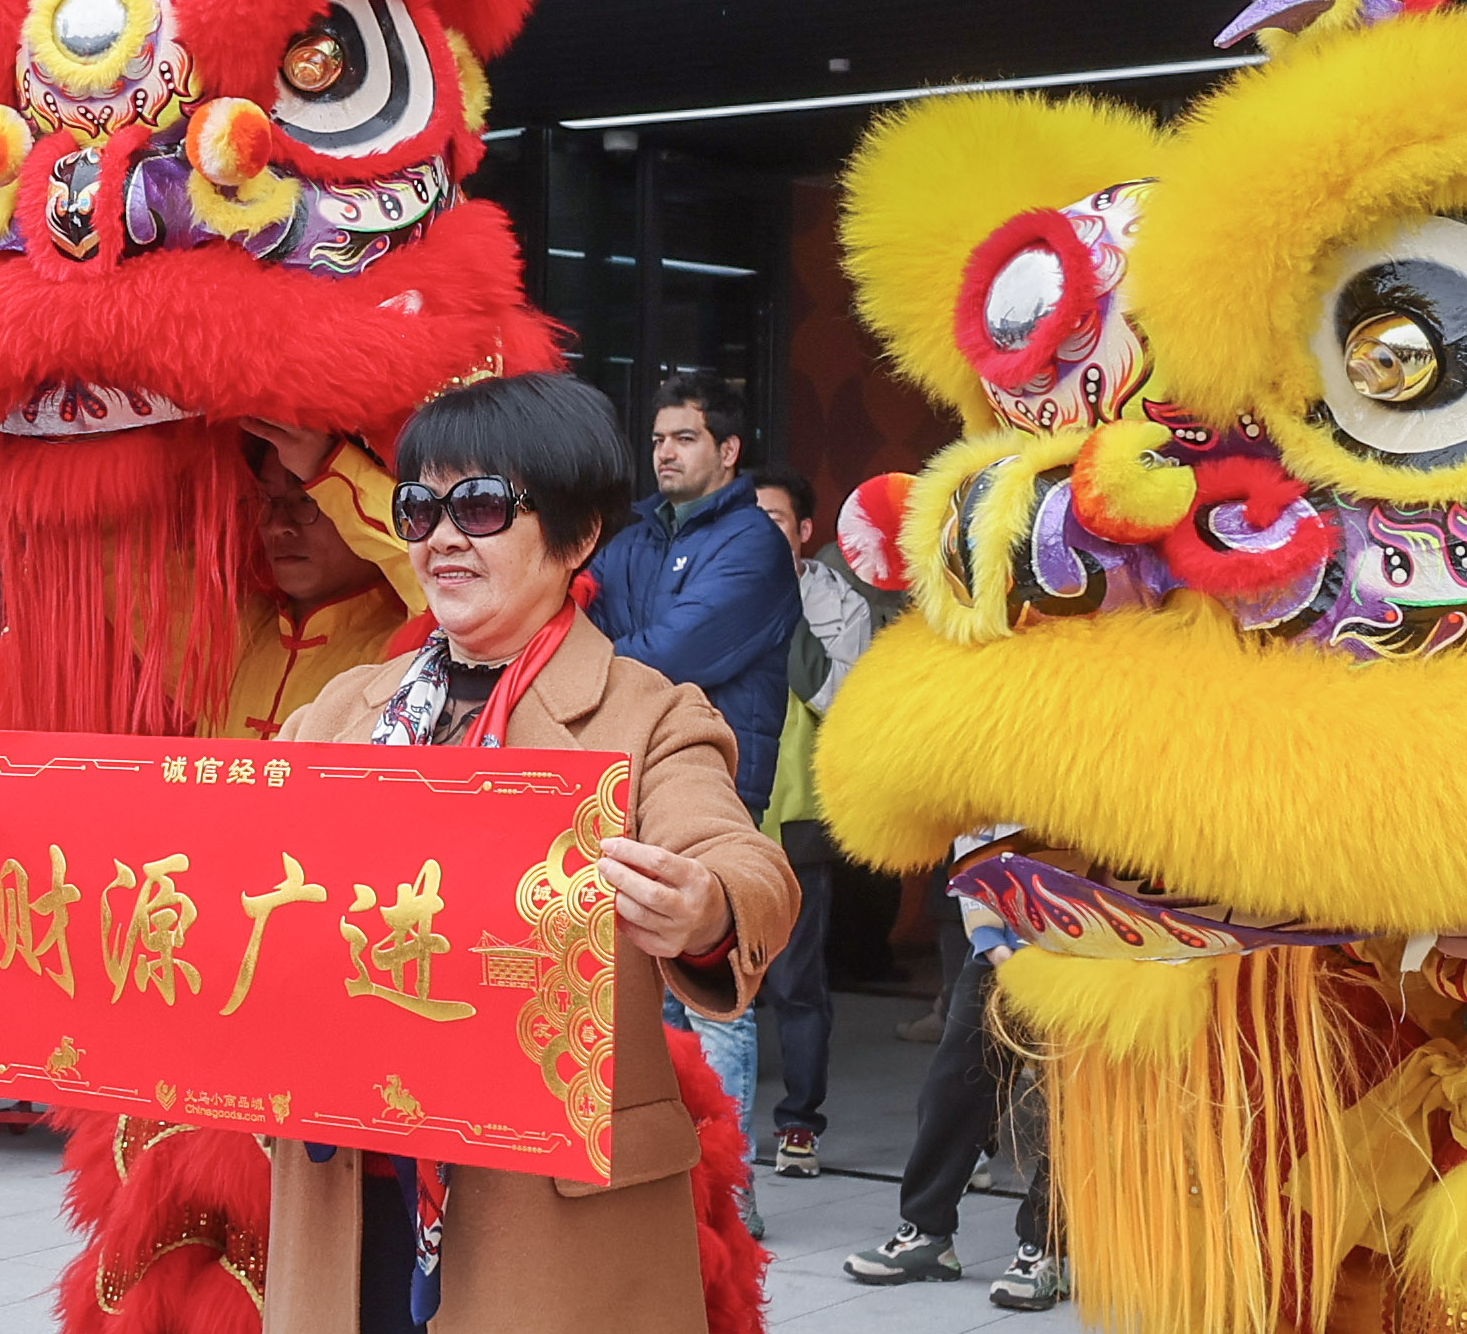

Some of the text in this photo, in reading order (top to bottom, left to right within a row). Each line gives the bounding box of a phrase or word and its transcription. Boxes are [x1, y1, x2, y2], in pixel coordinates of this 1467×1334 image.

[161, 755, 292, 787] 诚信经营
[184, 1103, 266, 1123] Chinagoods.com
